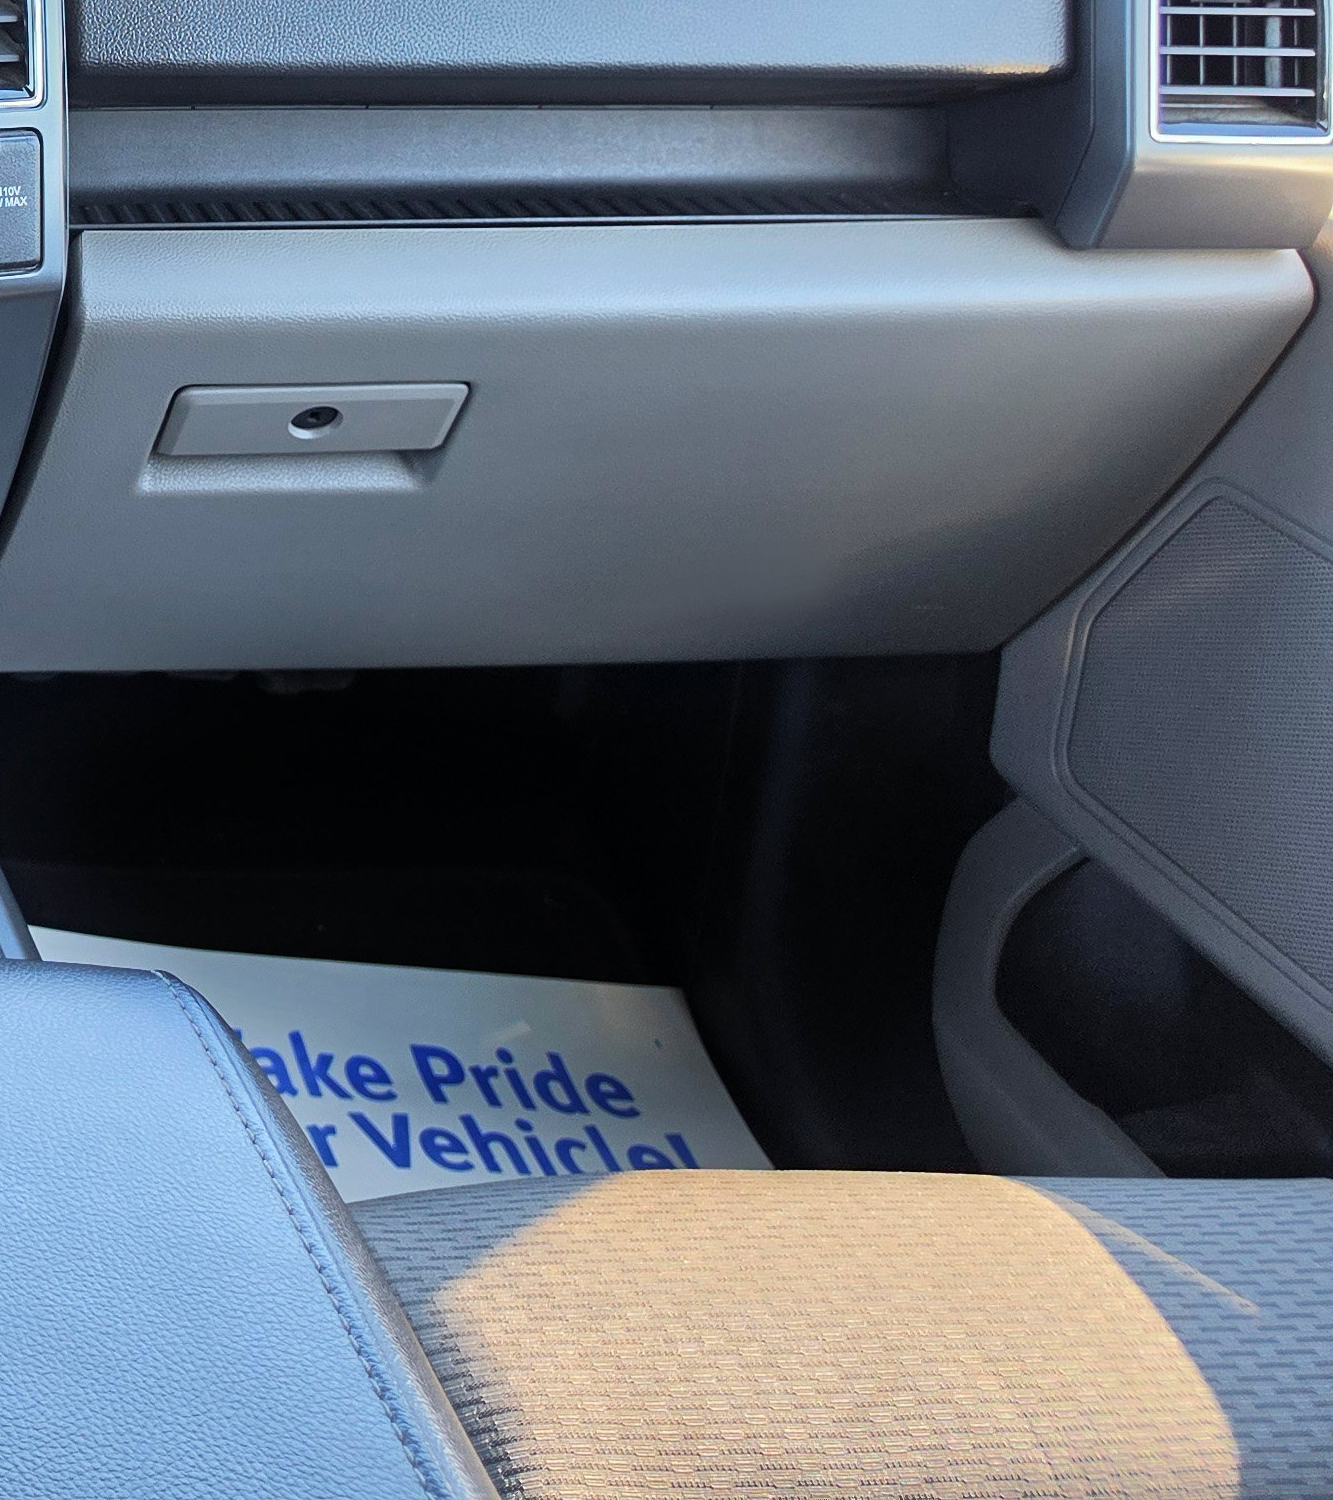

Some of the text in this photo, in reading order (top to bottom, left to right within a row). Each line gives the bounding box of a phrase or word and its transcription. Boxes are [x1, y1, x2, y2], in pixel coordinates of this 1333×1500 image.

[4, 196, 28, 208] MAX
[234, 1028, 641, 1119] ake Pride
